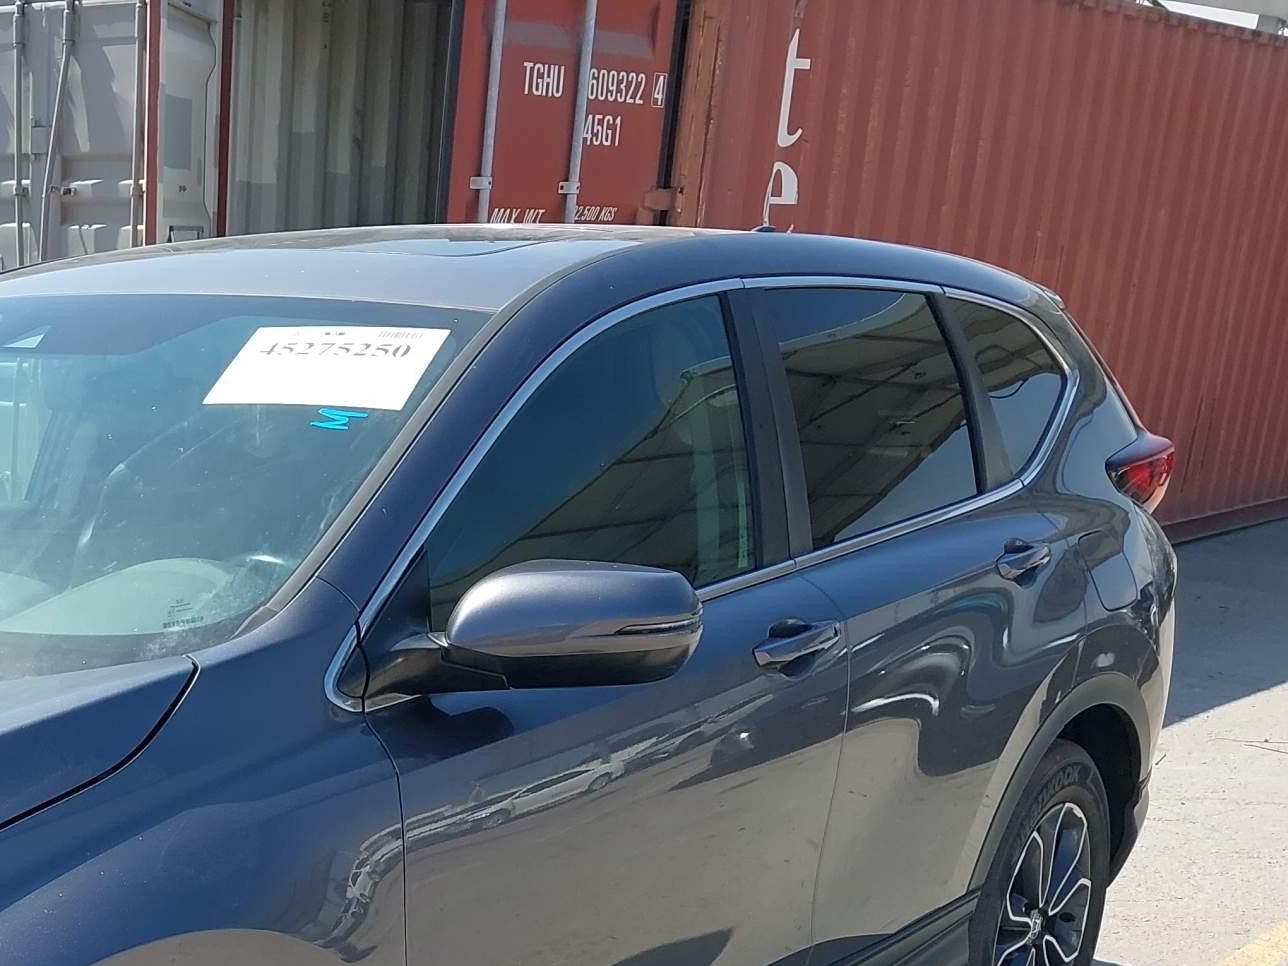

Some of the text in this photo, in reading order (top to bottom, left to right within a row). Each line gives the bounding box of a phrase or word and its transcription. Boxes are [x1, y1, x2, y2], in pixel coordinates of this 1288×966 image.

[523, 61, 666, 107] TGHU 609322 4
[583, 114, 621, 147] 45G1
[598, 206, 618, 222] KGS
[259, 342, 411, 358] 45275250
